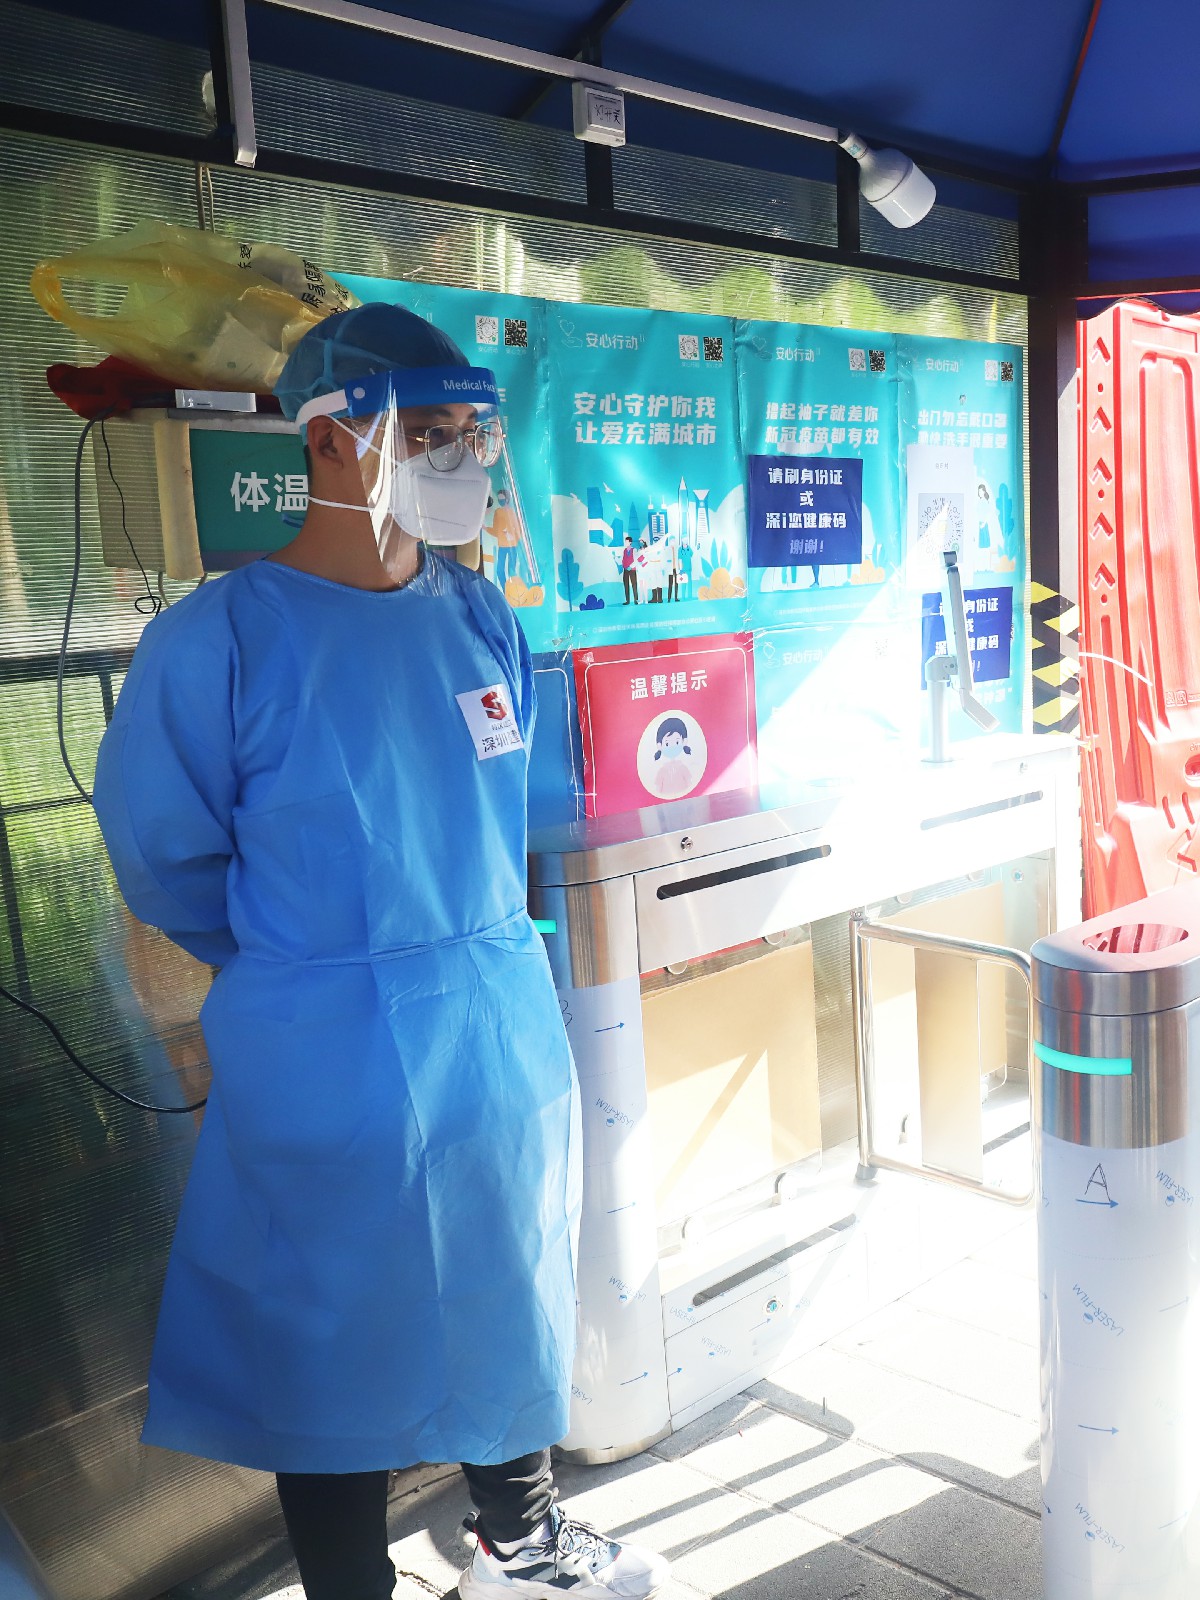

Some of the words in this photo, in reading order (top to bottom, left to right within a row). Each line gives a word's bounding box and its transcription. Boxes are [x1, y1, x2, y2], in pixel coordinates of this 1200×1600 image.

[586, 333, 638, 351] 安心行动
[776, 347, 815, 362] 安心行动
[926, 358, 959, 373] 安心行动
[443, 379, 482, 391] Medical
[573, 392, 716, 419] 安心守护你我
[766, 402, 878, 423] 撸起袖子就差你
[575, 421, 717, 446] 让爱充满城市
[765, 426, 879, 448] 新冠疫苗都有效
[767, 468, 843, 485] 请刷身份证
[230, 471, 309, 513] 体温
[799, 490, 814, 506] 或
[765, 512, 847, 529] 深i您健康码
[630, 670, 708, 700] 温馨提示
[595, 1097, 635, 1129] LASER-FILM
[1084, 1162, 1111, 1202] A
[1155, 1169, 1194, 1207] LASER-FILM
[1072, 1283, 1125, 1337] LASER-FILM
[1074, 1502, 1126, 1554] LASER-FILM
